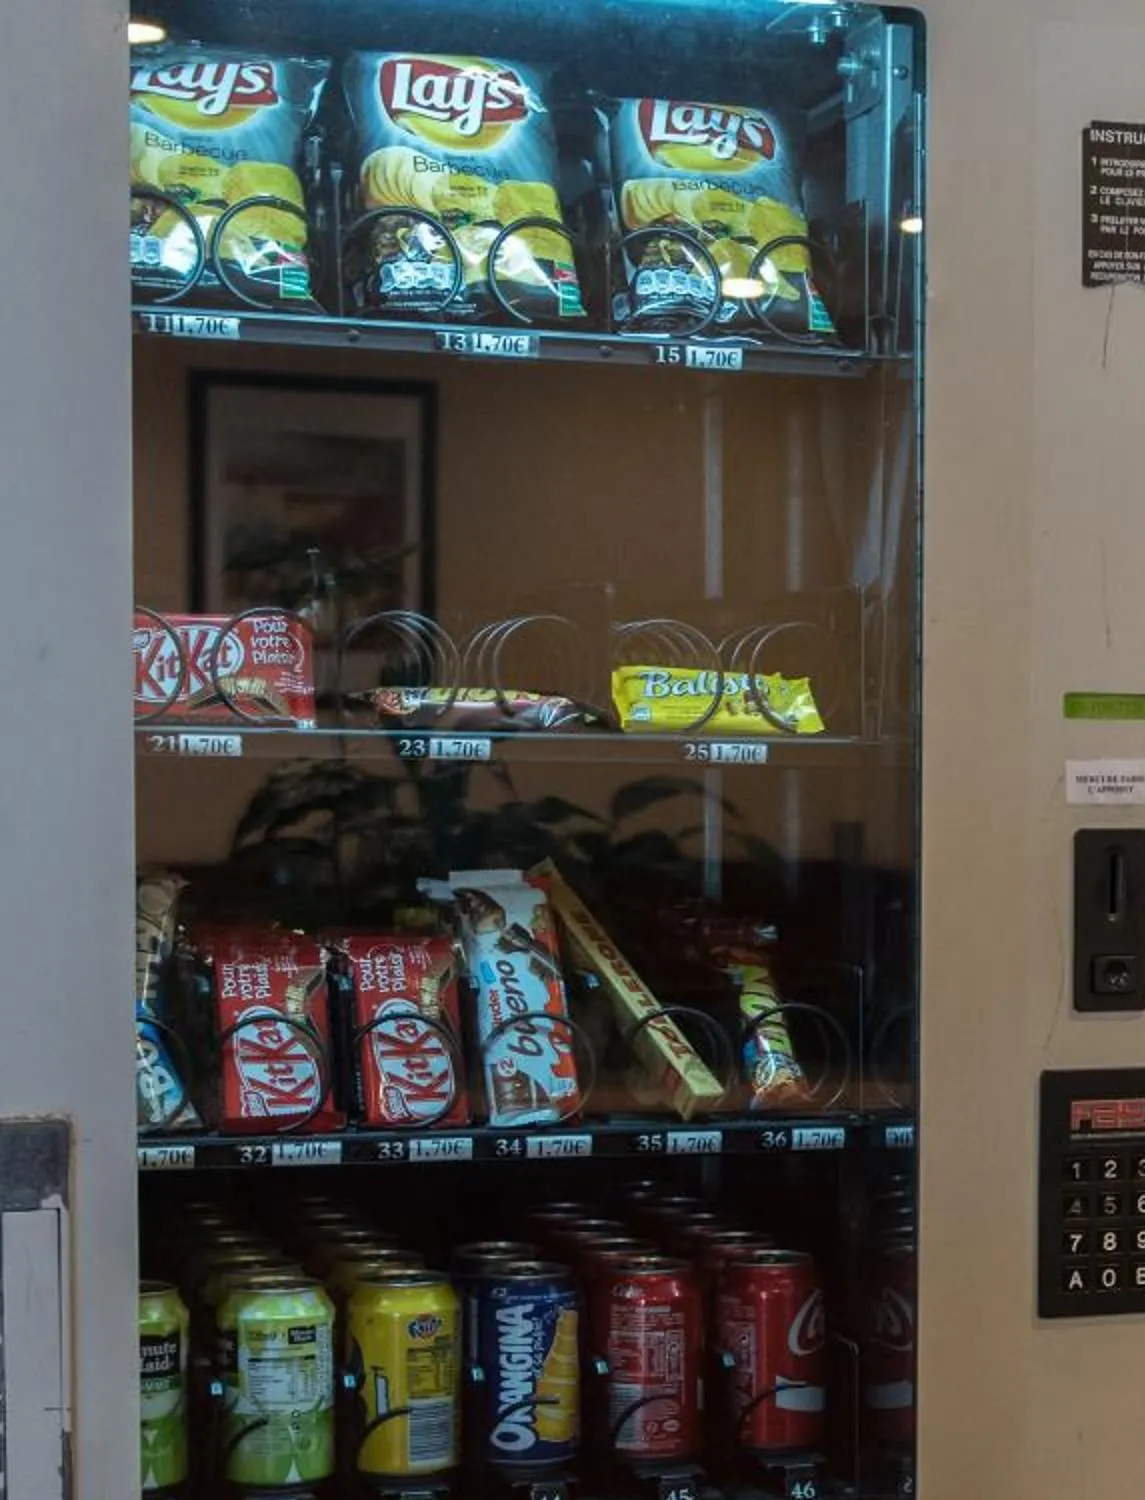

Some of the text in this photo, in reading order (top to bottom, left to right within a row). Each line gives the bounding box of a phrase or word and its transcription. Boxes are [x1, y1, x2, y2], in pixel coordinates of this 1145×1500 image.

[1090, 186, 1097, 195] 2
[1090, 214, 1098, 224] 3
[442, 332, 466, 351] 13
[656, 346, 681, 363] 15
[151, 735, 177, 752] 21
[400, 740, 427, 756] 23
[684, 744, 709, 761] 25
[496, 958, 545, 1058] bueno
[374, 1016, 449, 1101] KitKa
[496, 1138, 522, 1157] 34
[638, 1134, 662, 1151] 35
[762, 1130, 786, 1148] 36
[240, 1146, 267, 1164] 32
[377, 1141, 405, 1160] 33
[1072, 1162, 1081, 1179] 1
[1104, 1160, 1117, 1179] 2
[1070, 1199, 1082, 1215] 4
[1104, 1196, 1117, 1215] 5
[1070, 1234, 1082, 1252] 7
[1103, 1231, 1117, 1251] 8
[1069, 1270, 1083, 1289] A
[490, 1302, 536, 1450] ORANGINA
[790, 1480, 816, 1499] 46
